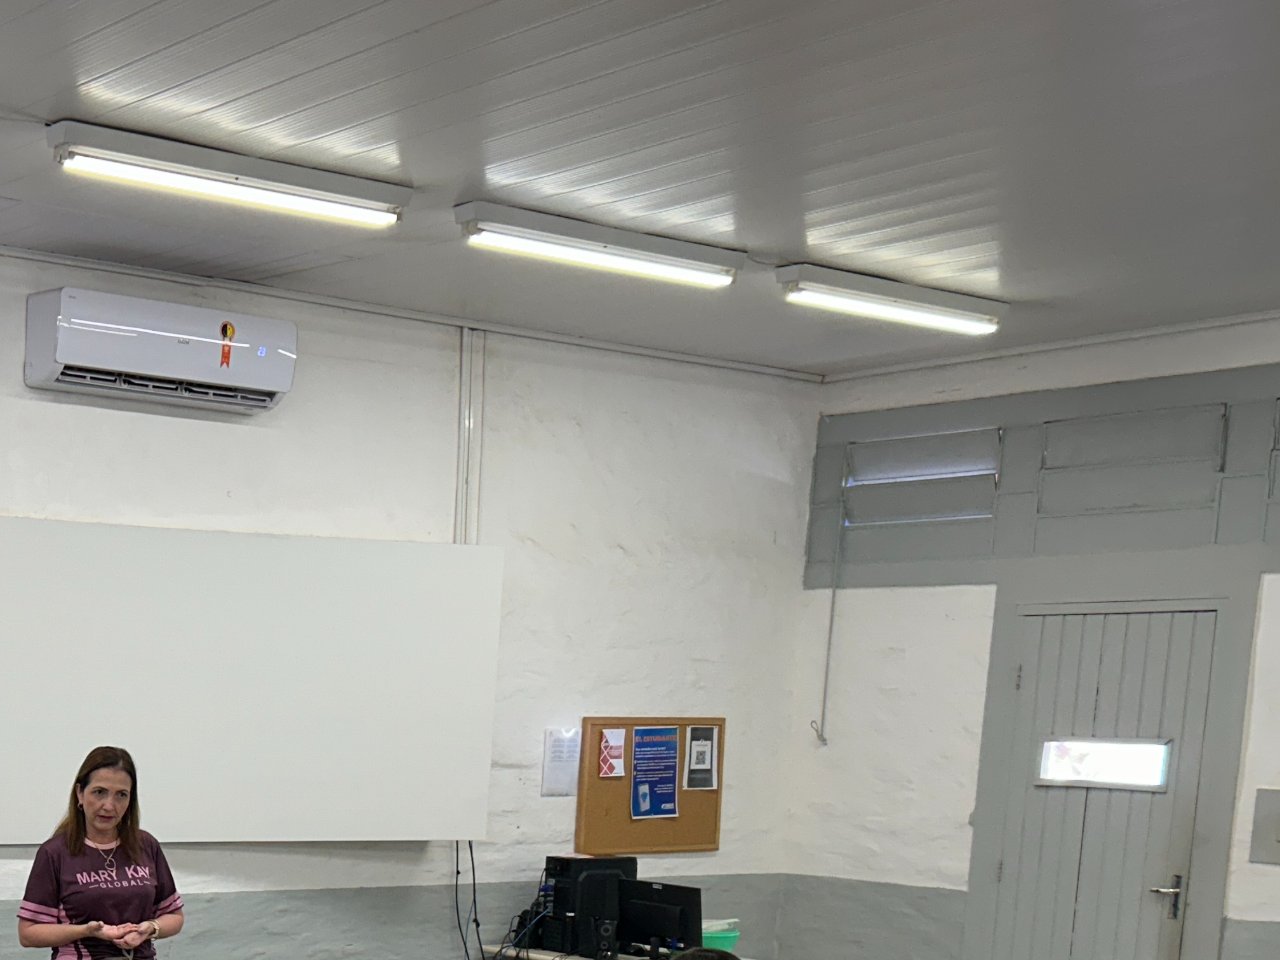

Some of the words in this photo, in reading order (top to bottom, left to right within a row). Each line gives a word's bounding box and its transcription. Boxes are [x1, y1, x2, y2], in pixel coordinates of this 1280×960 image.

[75, 870, 118, 885] MARY
[125, 864, 150, 879] KAY
[99, 879, 144, 889] GLOBAL
